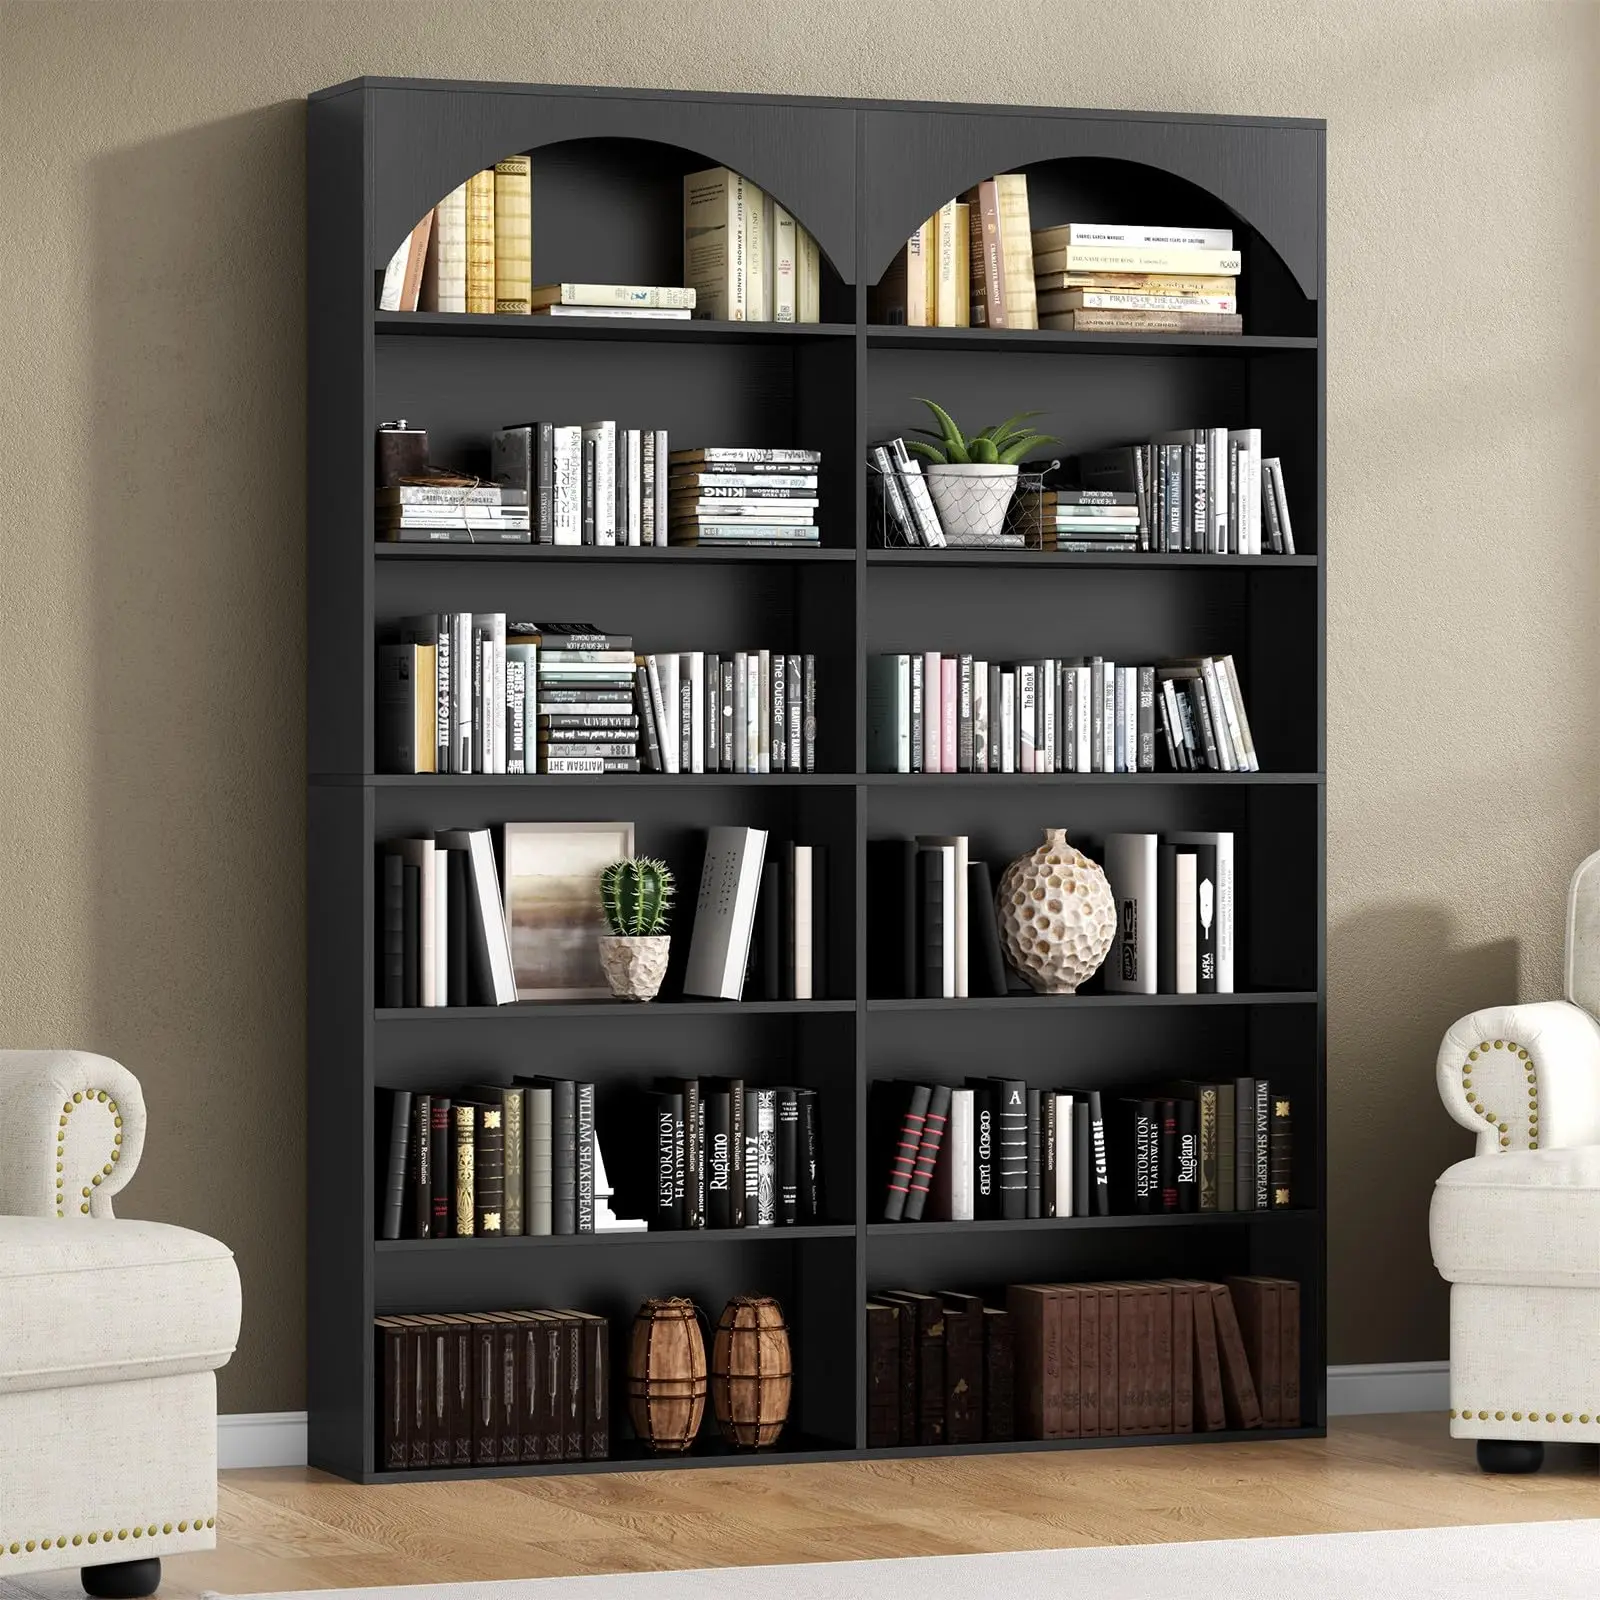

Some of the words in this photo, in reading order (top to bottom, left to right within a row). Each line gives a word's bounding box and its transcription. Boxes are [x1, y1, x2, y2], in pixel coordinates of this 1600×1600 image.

[1220, 259, 1240, 269] PICADOR
[746, 448, 774, 463] FARM
[1195, 444, 1206, 490] ИРВИН
[704, 487, 743, 498] KING
[1171, 472, 1180, 505] FINANCE
[1171, 508, 1180, 533] WATER
[1195, 492, 1206, 532] УЭЛШ
[438, 633, 449, 691] ИРВИН
[514, 662, 525, 690] PENIS
[775, 657, 784, 678] The
[962, 656, 969, 664] TO
[962, 665, 970, 676] KILL
[506, 662, 514, 708] SURGERY
[1025, 672, 1033, 692] Book
[774, 680, 784, 726] Outsider
[962, 682, 970, 718] MOCKINGBIRD
[1025, 694, 1033, 708] The
[438, 695, 449, 747] УЭЛШ
[514, 692, 525, 751] REDUCTION
[584, 718, 608, 726] BEAUTY
[608, 718, 630, 726] BLACK
[792, 706, 800, 738] GRAVITY'S
[1048, 734, 1052, 742] OF
[610, 745, 630, 756] 1984
[792, 738, 800, 768] RAINBOW
[1202, 952, 1211, 979] KAFKA
[580, 1086, 592, 1142] WILLIAM
[734, 1087, 742, 1121] REVEALING
[1009, 1090, 1022, 1105] A
[1256, 1082, 1268, 1133] WILLIAM
[420, 1102, 428, 1136] REVEALING
[690, 1133, 698, 1172] Revolution
[734, 1132, 743, 1171] Revolution
[746, 1136, 758, 1145] Z
[1092, 1118, 1107, 1174] GALLERIE
[1137, 1116, 1148, 1198] RESTORATION
[1150, 1122, 1159, 1190] HARDWARE
[421, 1146, 430, 1185] Revolution
[660, 1112, 673, 1207] RESTORATION
[674, 1120, 684, 1198] HARDWARE
[709, 1134, 730, 1190] Rugiano
[746, 1147, 758, 1198] GALLERIE
[1178, 1134, 1198, 1184] Rugiano
[1257, 1136, 1268, 1208] SHAKESPEARE
[580, 1146, 592, 1230] SHAKESPEARE
[1096, 1174, 1108, 1185] Z
